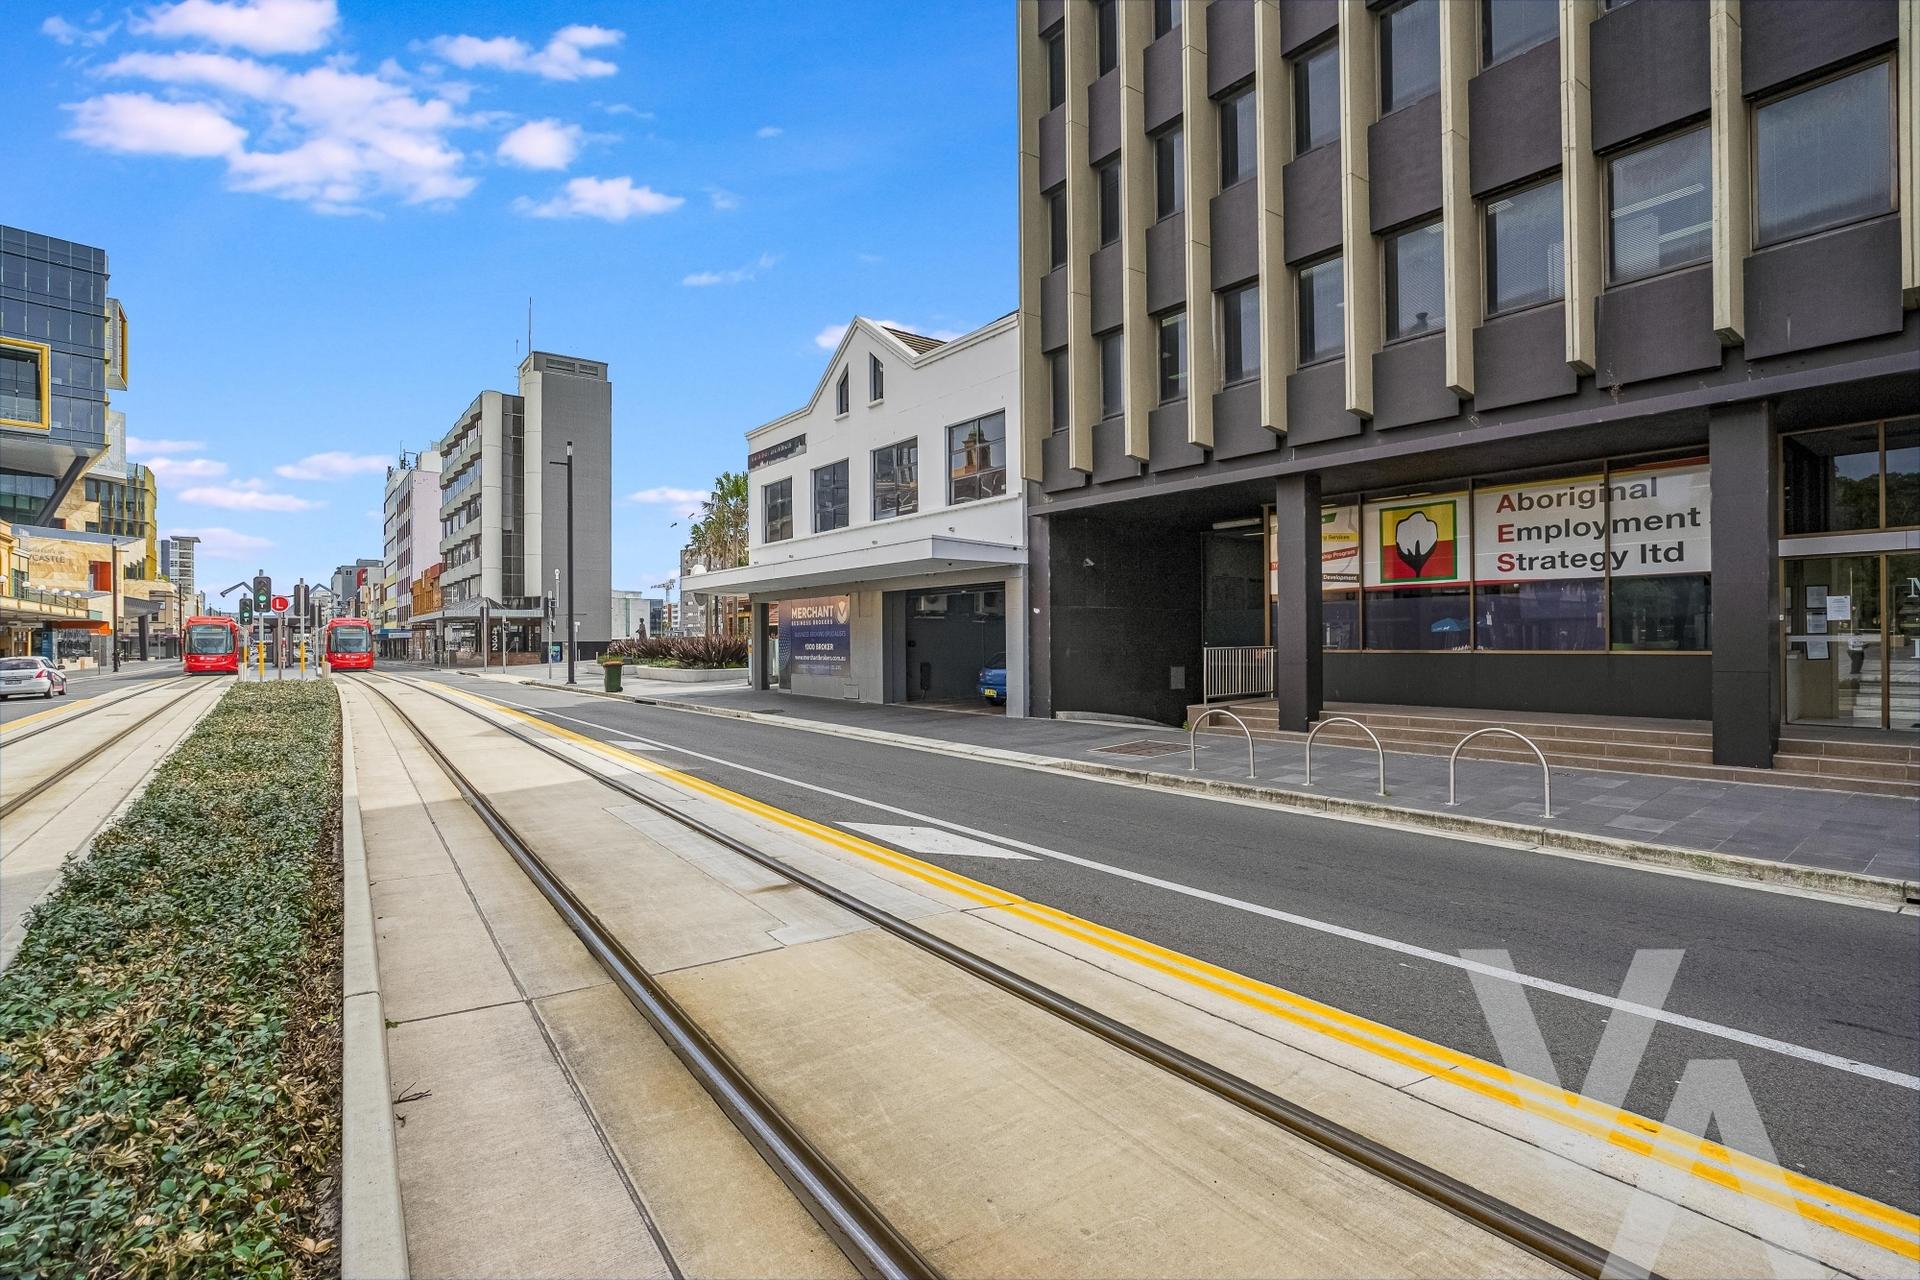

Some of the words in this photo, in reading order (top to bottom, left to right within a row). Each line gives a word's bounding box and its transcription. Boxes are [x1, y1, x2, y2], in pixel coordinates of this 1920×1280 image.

[1496, 476, 1657, 514] Aboriginal
[1497, 507, 1701, 544] Employment
[1496, 549, 1629, 573] Strategy
[1640, 541, 1685, 564] ltd
[791, 605, 834, 619] MERCHANT
